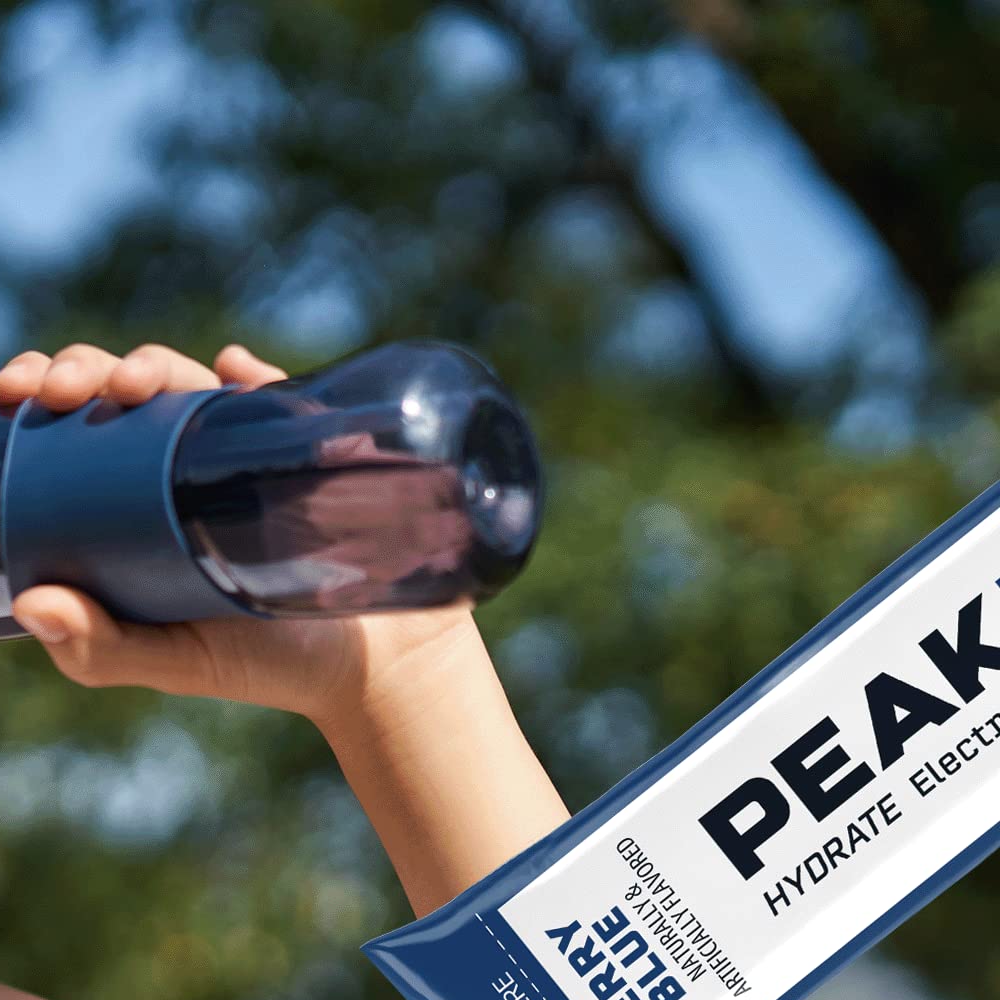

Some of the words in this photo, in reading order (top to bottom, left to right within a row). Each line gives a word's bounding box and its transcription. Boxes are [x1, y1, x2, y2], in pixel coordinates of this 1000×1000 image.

[616, 836, 682, 907] FLAVORED
[624, 882, 642, 901] &
[763, 792, 903, 917] HYDRATE
[632, 897, 706, 983] NATURALLY
[671, 907, 752, 997] ARTIFICIALLY
